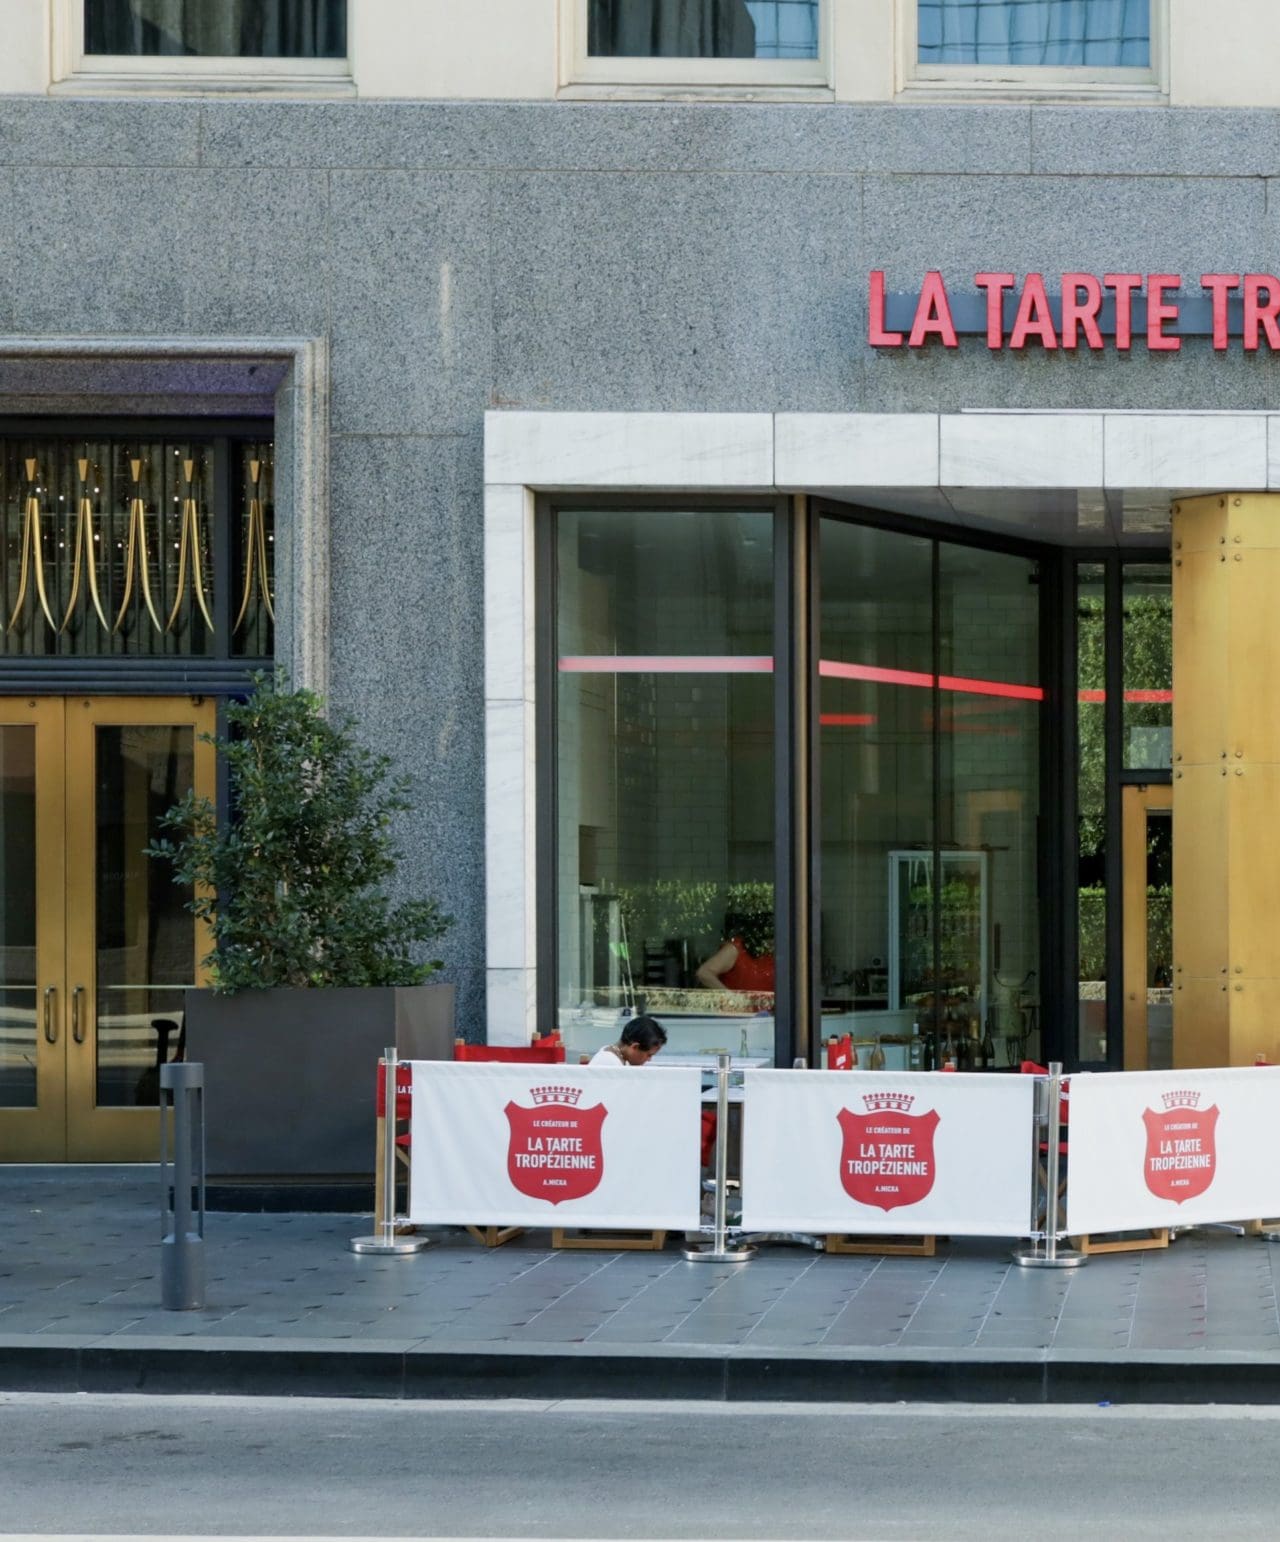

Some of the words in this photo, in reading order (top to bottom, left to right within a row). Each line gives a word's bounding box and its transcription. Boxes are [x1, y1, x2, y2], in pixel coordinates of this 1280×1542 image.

[869, 270, 959, 348] LA
[974, 272, 1181, 350] TARTE
[527, 1137, 543, 1151] LA
[546, 1137, 582, 1152] TARTE
[860, 1143, 876, 1158] LA
[878, 1144, 915, 1159] TARTE
[1160, 1140, 1172, 1154] LA
[1174, 1138, 1202, 1153] TARTE
[515, 1151, 596, 1169] TROPÉZIENNE
[847, 1158, 928, 1176] TROPÉZIENNE
[1150, 1153, 1211, 1171] TROPÉZIENNE
